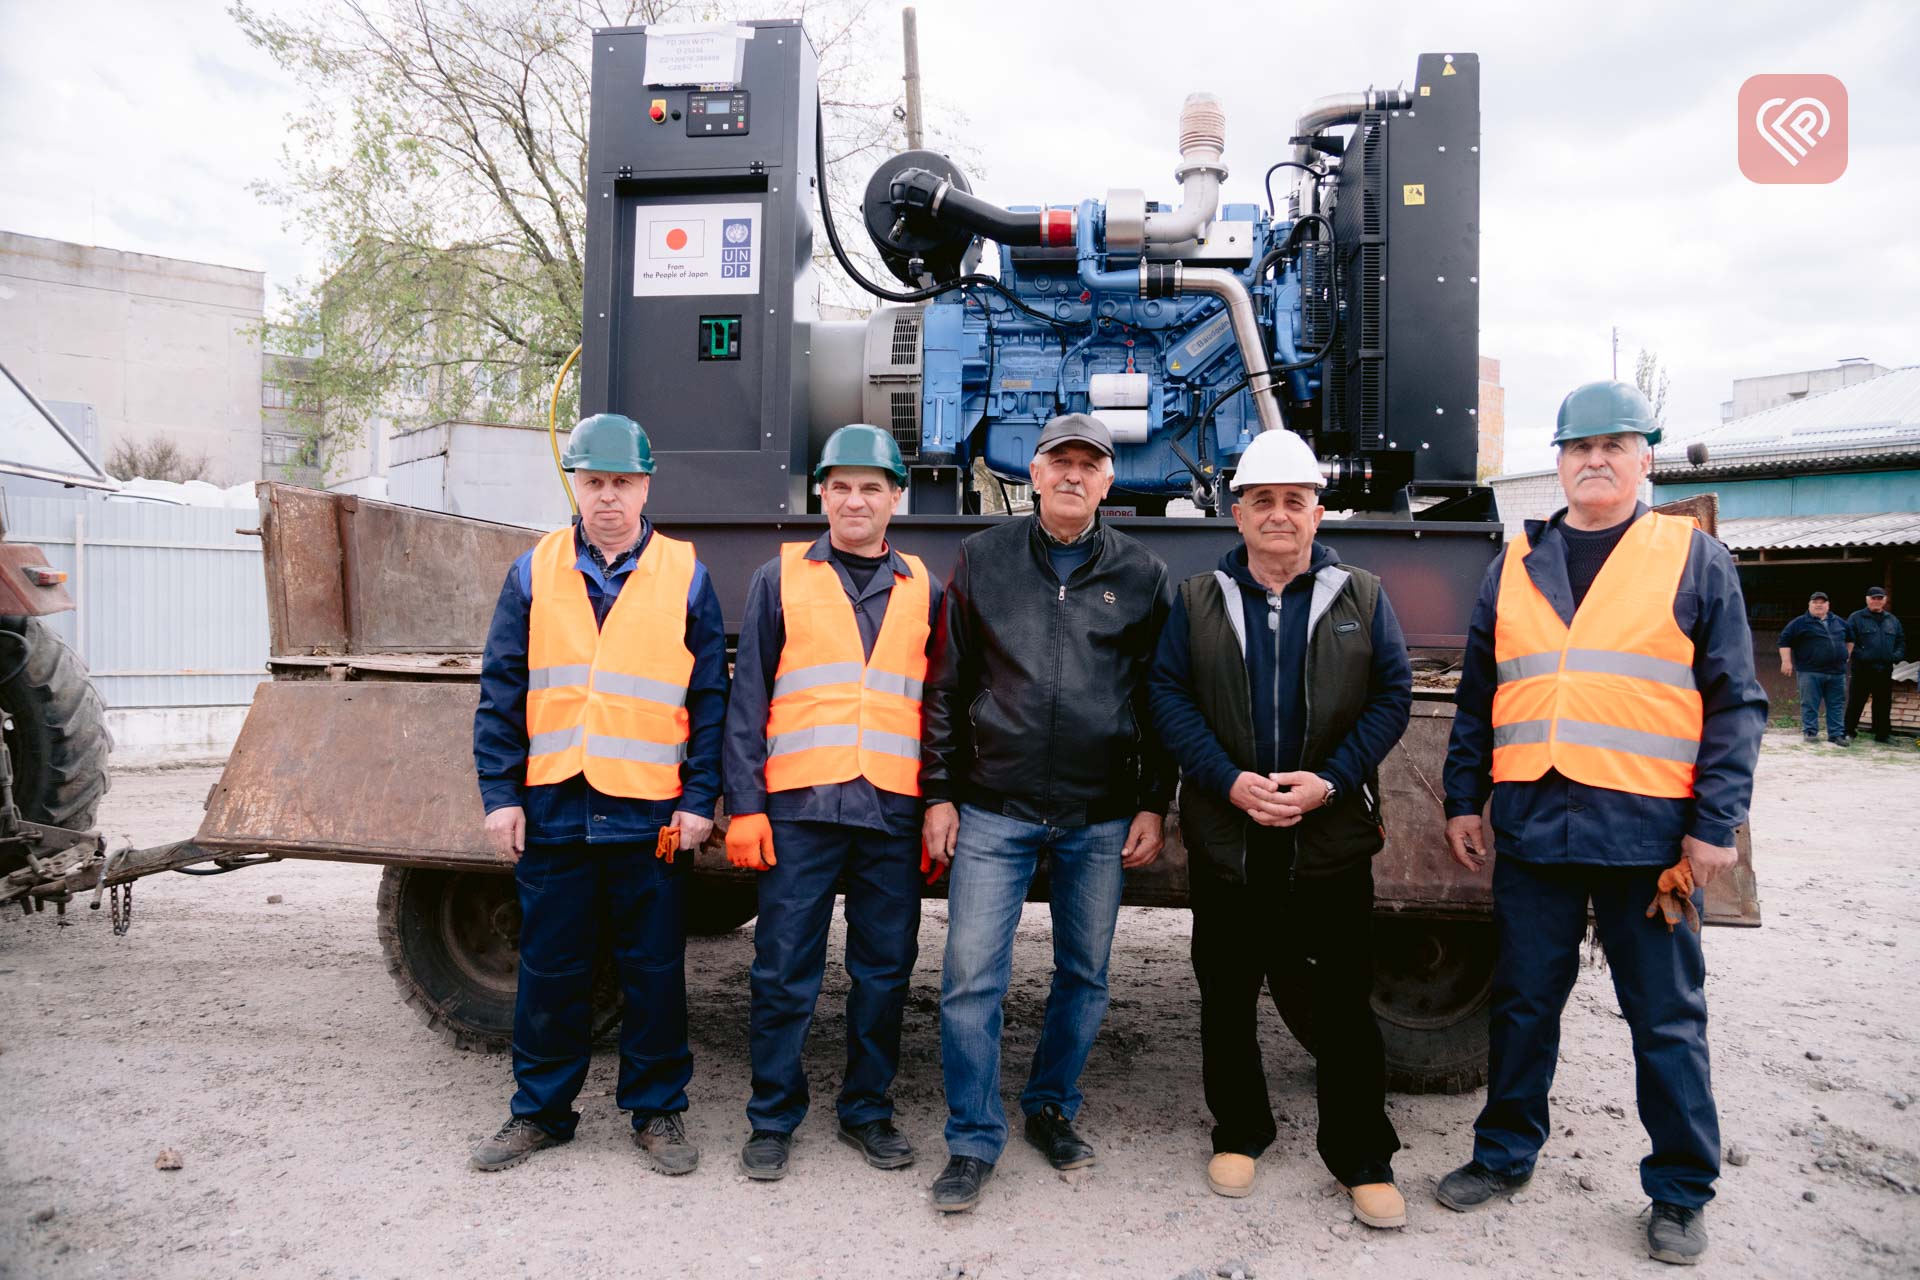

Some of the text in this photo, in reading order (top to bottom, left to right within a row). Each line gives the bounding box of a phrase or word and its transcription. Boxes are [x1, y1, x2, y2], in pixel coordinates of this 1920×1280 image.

[655, 271, 678, 279] People
[679, 270, 687, 278] of
[688, 271, 709, 279] Japan
[1197, 320, 1230, 349] Baudouin
